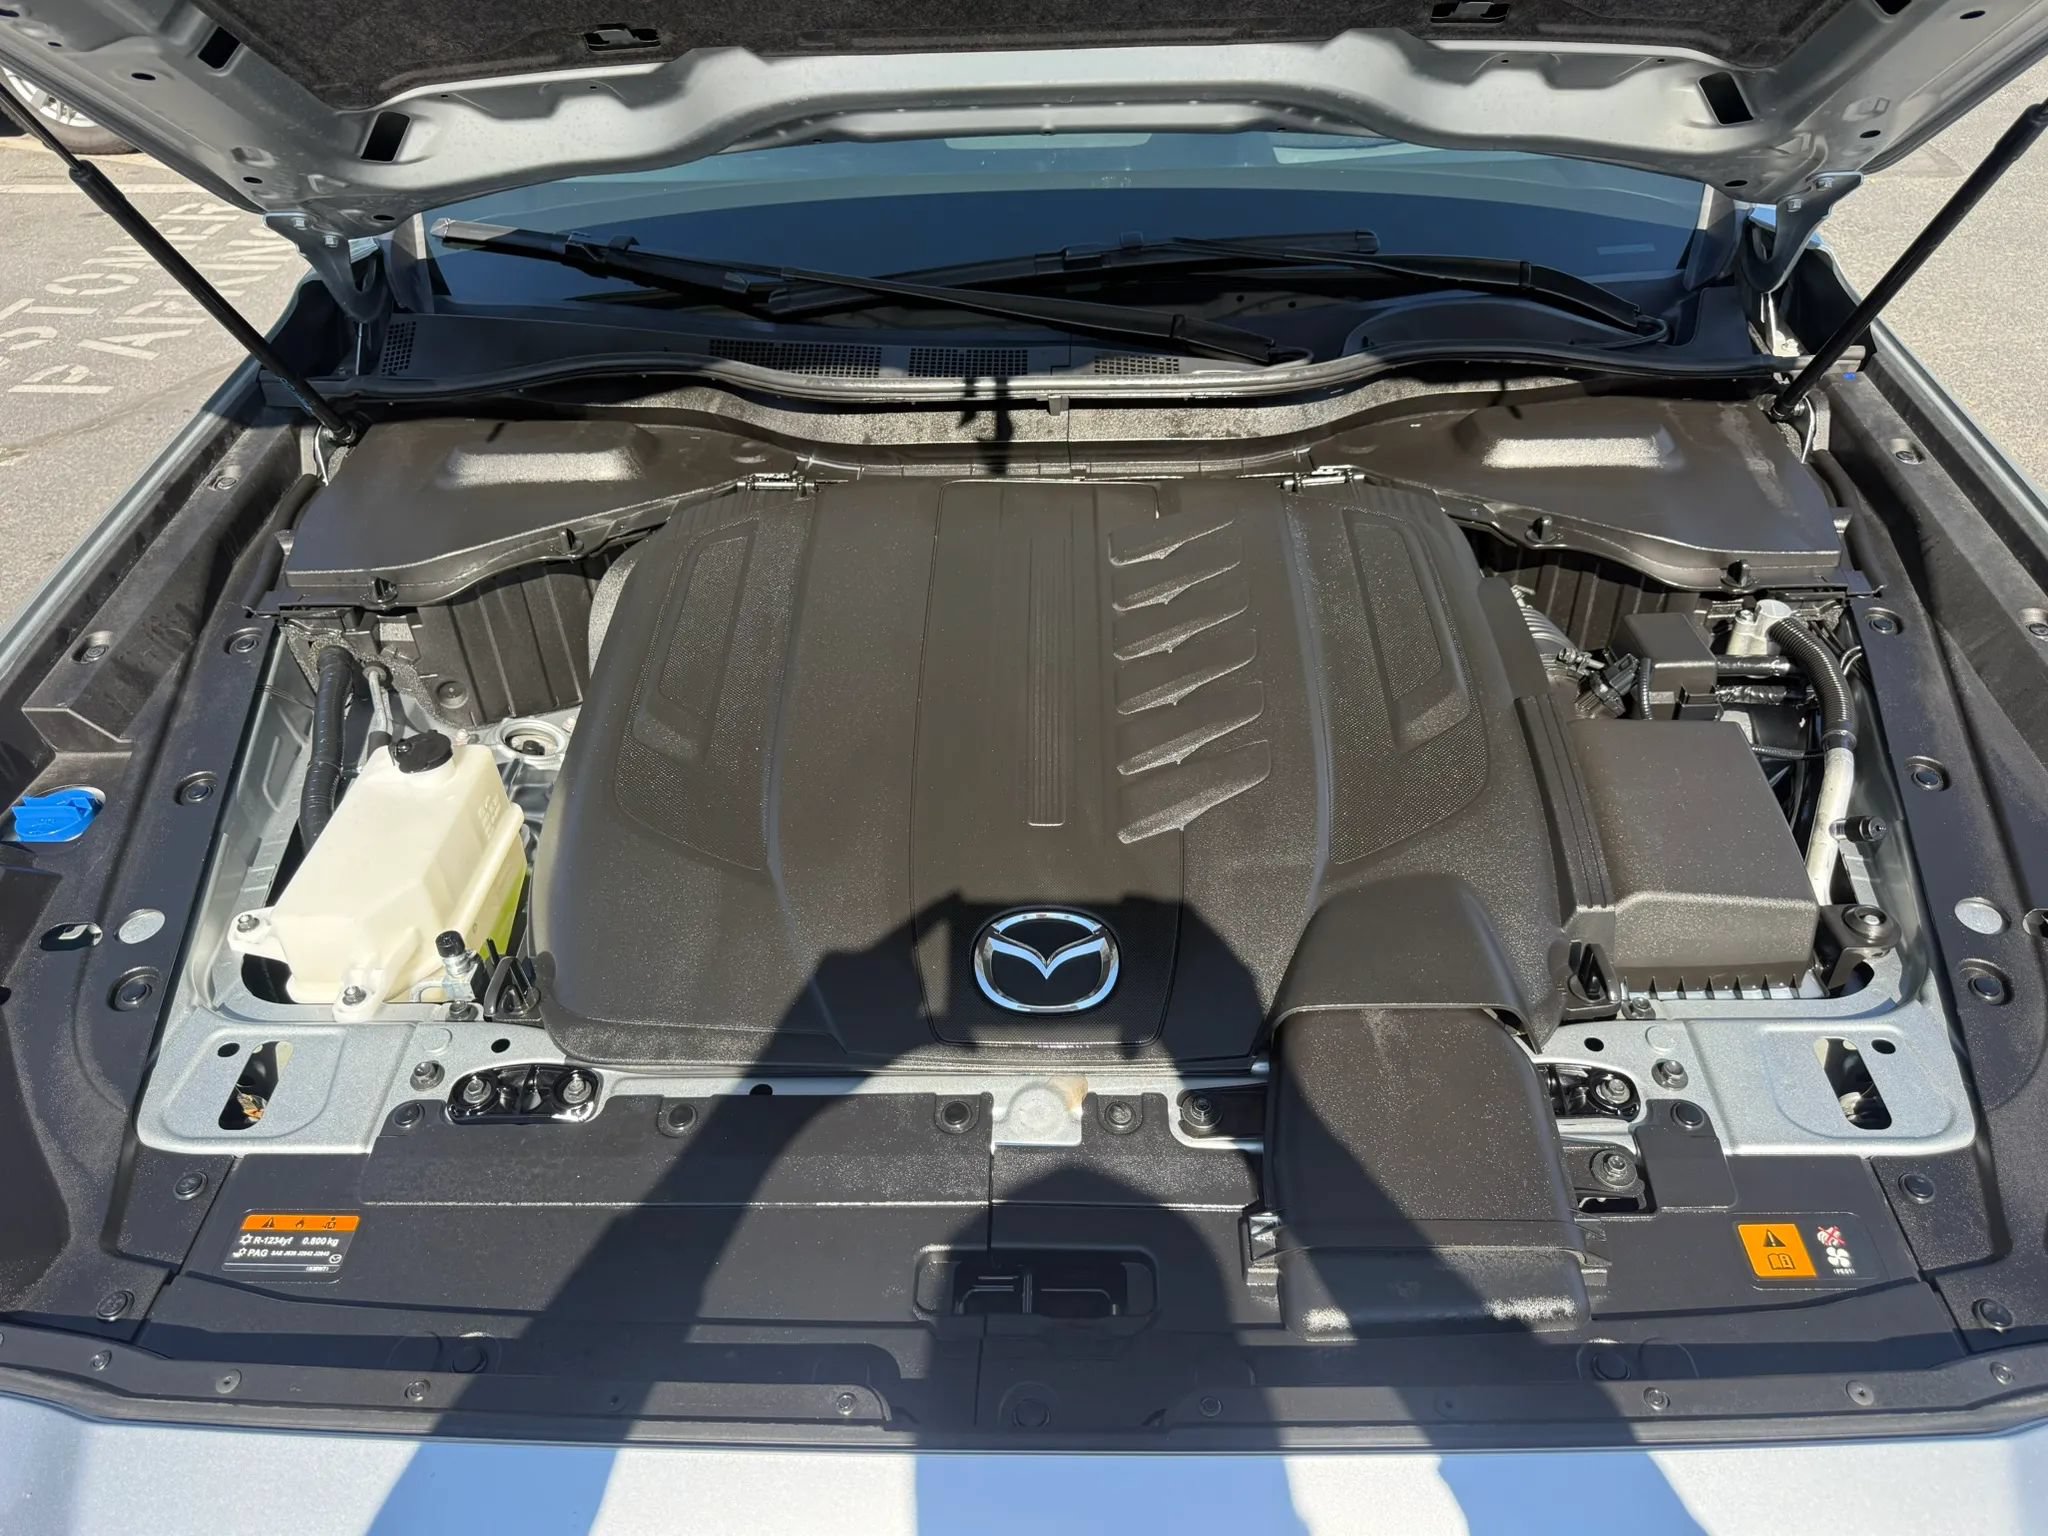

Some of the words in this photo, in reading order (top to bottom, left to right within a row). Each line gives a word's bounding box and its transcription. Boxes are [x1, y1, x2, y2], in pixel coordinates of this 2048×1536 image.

[253, 1236, 294, 1247] R-1234yf
[327, 1237, 340, 1247] kg
[247, 1248, 269, 1257] PAG
